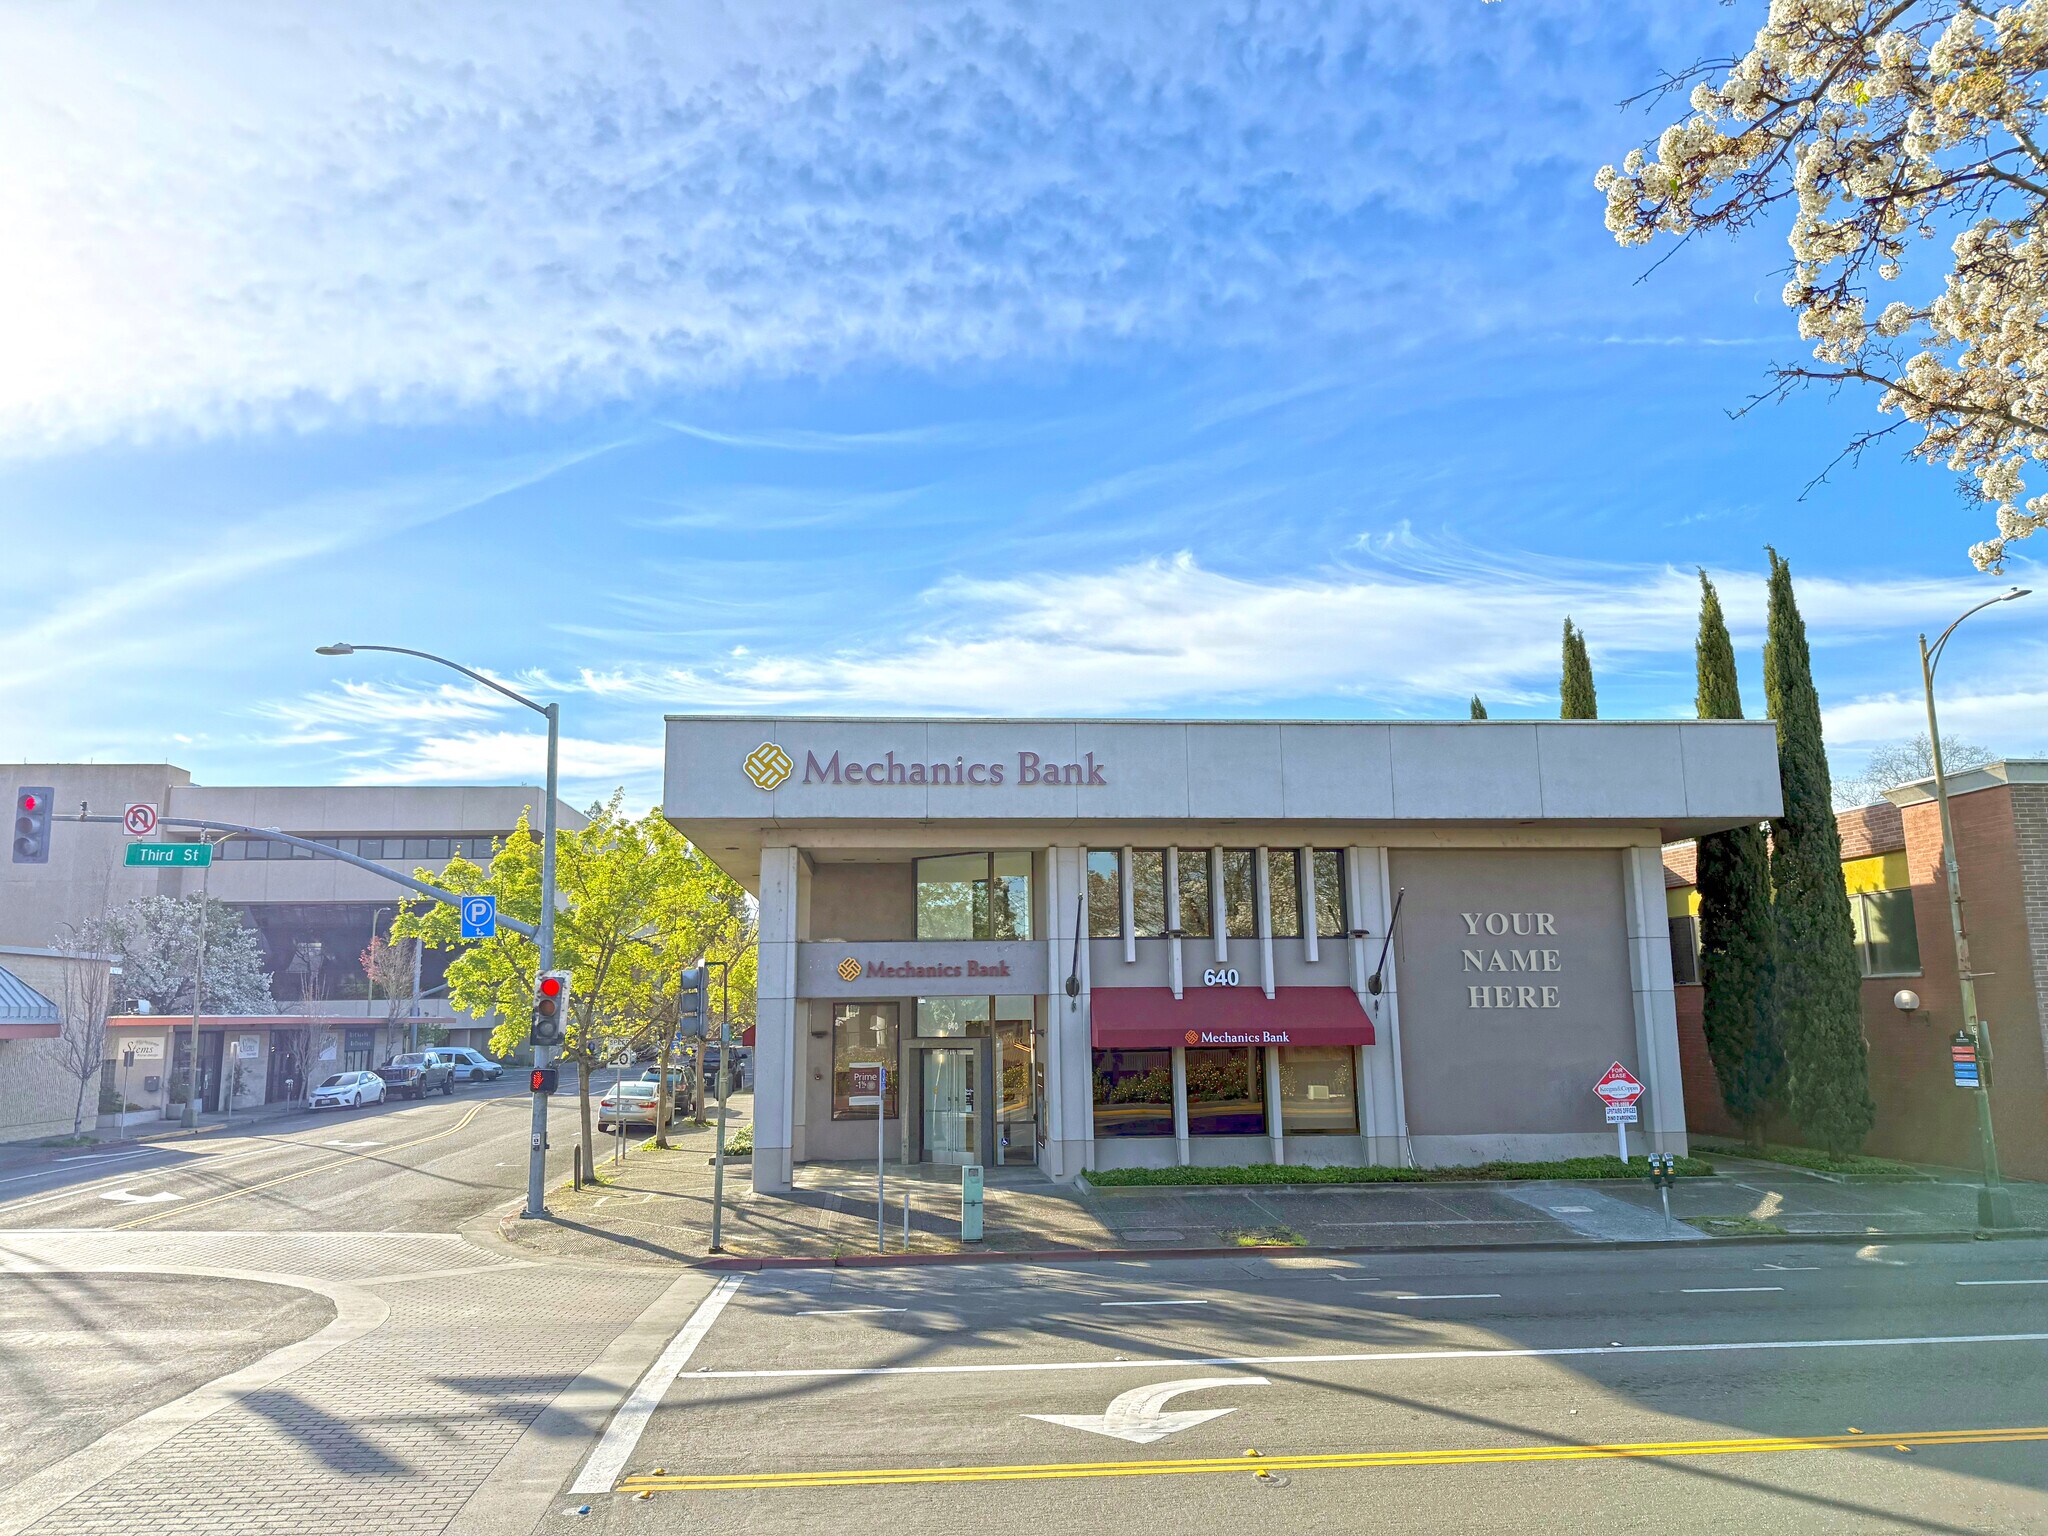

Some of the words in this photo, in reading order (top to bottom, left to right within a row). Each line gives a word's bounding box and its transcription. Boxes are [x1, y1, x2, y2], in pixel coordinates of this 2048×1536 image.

[802, 750, 1005, 785] Mechanics
[1017, 751, 1108, 785] Bank
[140, 848, 174, 861] Third
[183, 848, 199, 861] St
[471, 903, 487, 922] P
[1461, 912, 1558, 935] YOUR
[866, 960, 962, 978] Mechanics
[967, 960, 1011, 977] Bank
[1461, 949, 1562, 972] NAME
[1203, 968, 1240, 986] 640
[1467, 985, 1561, 1008] HERE
[1201, 1031, 1260, 1043] Mechanics
[1262, 1031, 1290, 1043] Bank
[854, 1072, 877, 1081] Prime
